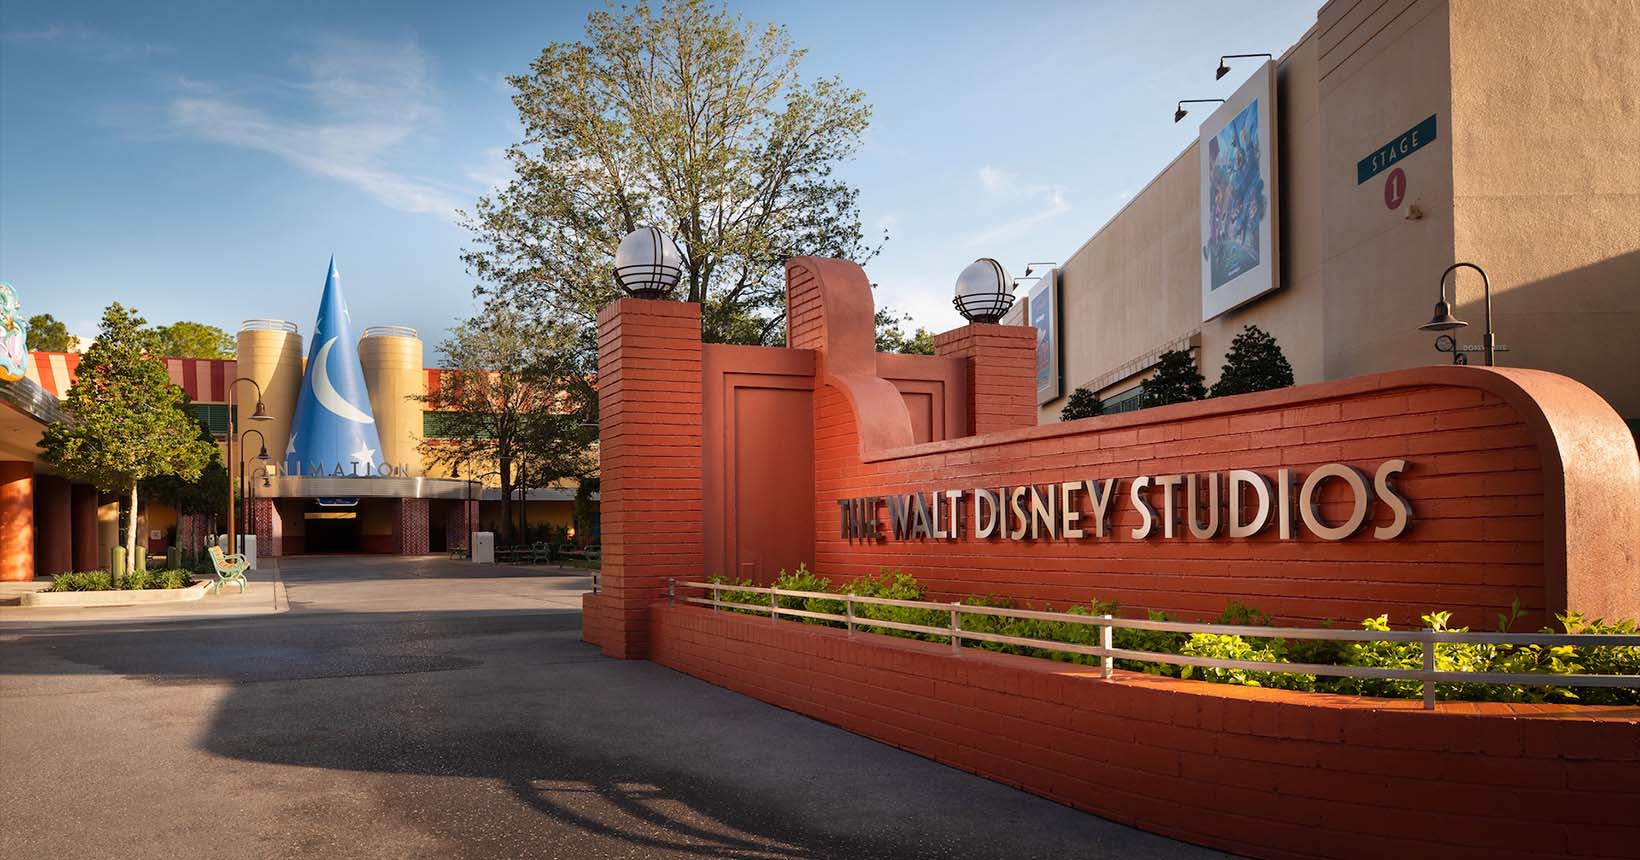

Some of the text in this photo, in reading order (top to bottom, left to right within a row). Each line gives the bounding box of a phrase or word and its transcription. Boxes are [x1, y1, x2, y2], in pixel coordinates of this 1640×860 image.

[1370, 131, 1419, 172] STAGE
[1391, 175, 1401, 203] 1
[265, 460, 409, 477] NIMATION
[837, 459, 1410, 541] THE WALT DISNEY STUDIOS
